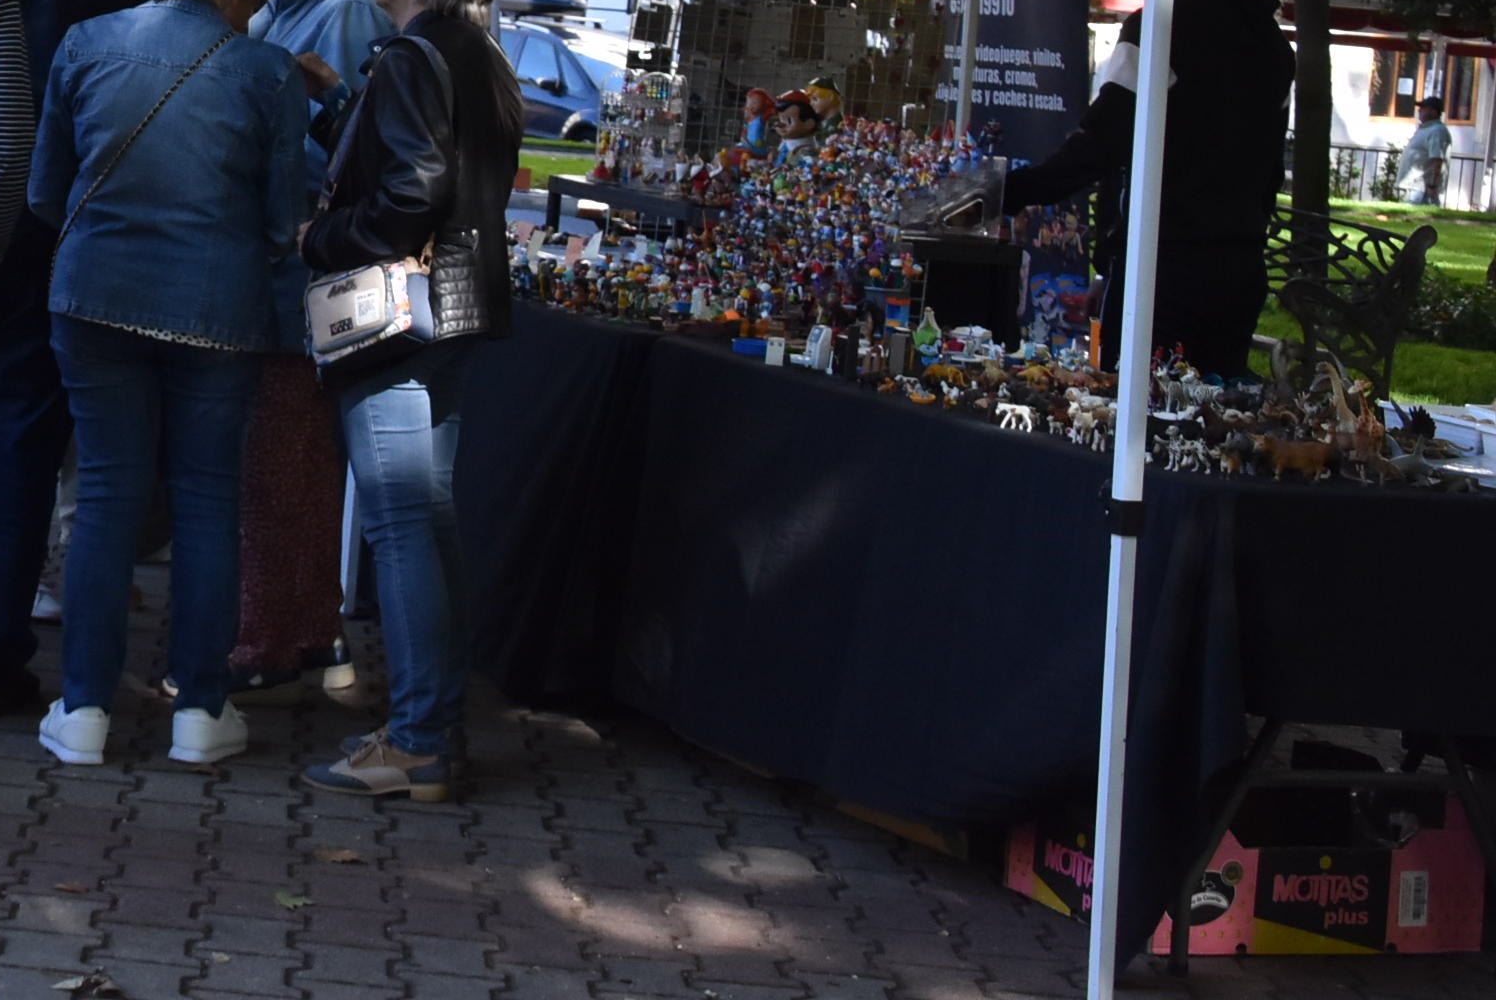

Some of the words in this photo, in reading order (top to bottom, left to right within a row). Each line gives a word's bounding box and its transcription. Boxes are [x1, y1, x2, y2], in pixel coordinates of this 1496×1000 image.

[984, 90, 991, 106] y
[993, 90, 1027, 108] coches
[1034, 93, 1067, 112] escala.
[1323, 908, 1369, 929] plus
